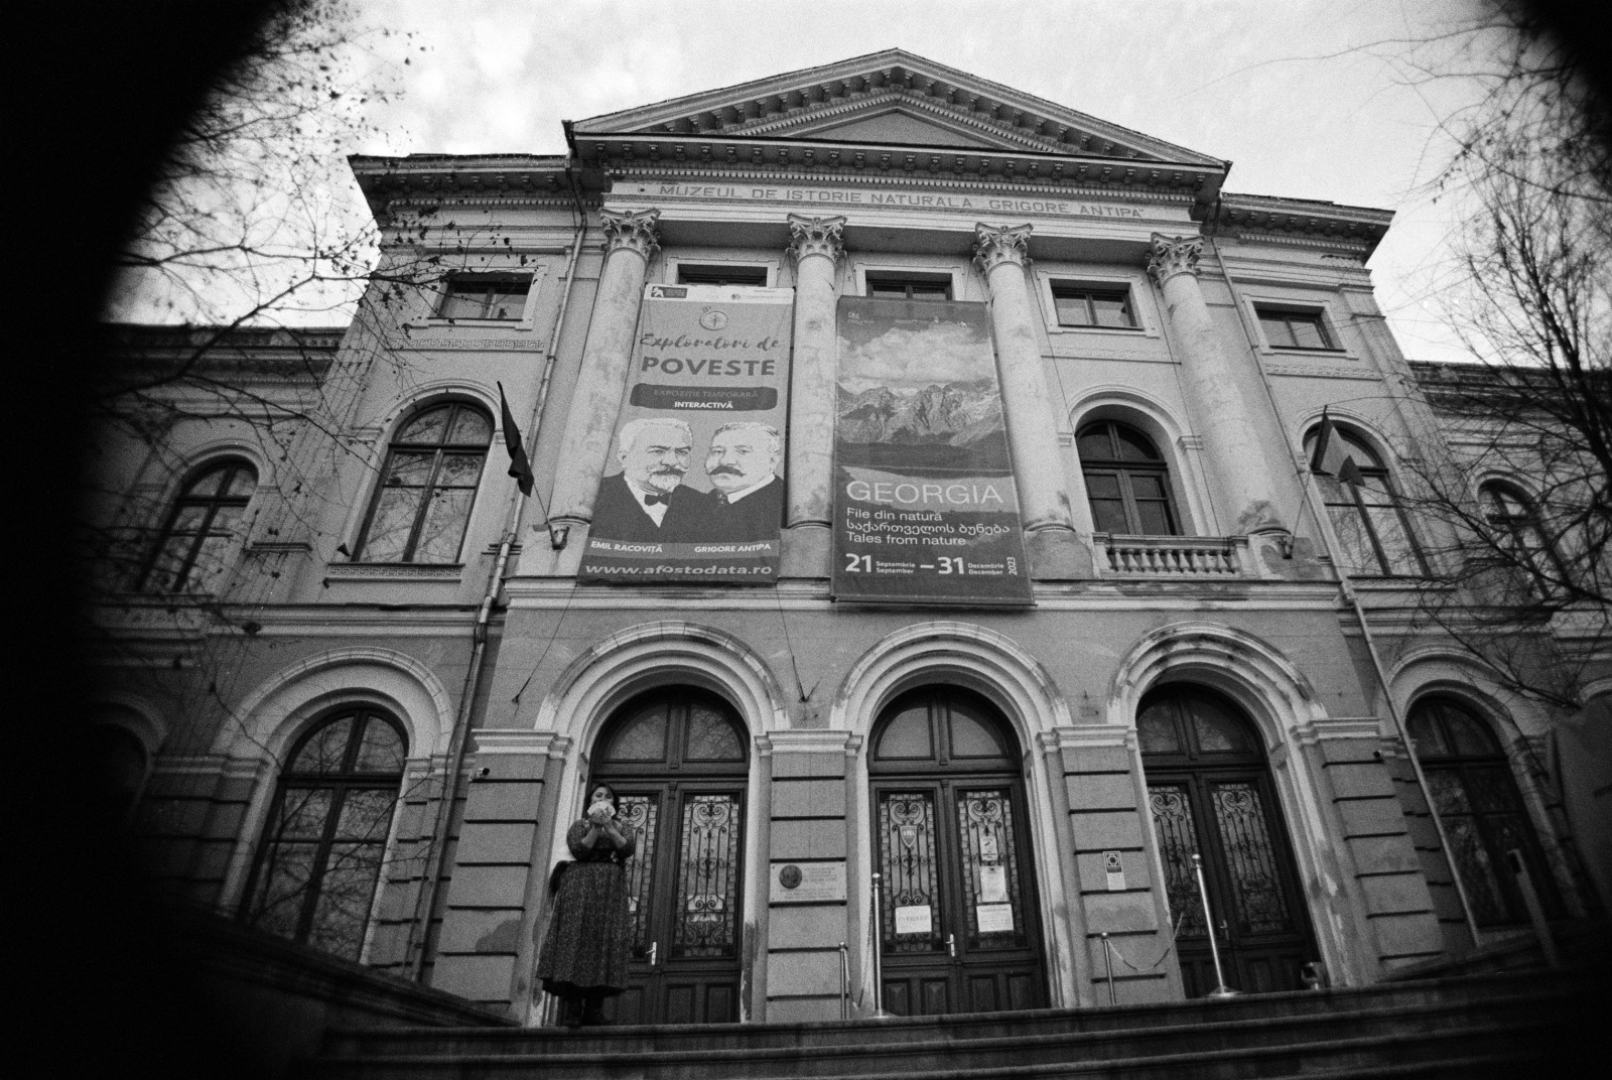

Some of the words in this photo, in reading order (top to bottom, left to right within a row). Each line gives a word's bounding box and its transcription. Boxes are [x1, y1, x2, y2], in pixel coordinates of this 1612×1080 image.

[659, 185, 742, 199] MUZEUL
[751, 188, 778, 200] DE
[786, 190, 862, 203] ISTORIE
[870, 193, 972, 208] NATURALA
[640, 333, 750, 351] Exploratori
[757, 336, 780, 351] de
[641, 356, 776, 376] POVESTE
[674, 401, 734, 409] INTERACTIVĂ
[846, 480, 1004, 504] GEORGIA
[846, 507, 870, 519] File
[874, 509, 896, 521] din
[590, 540, 612, 550] EMIL
[846, 531, 882, 544] Tales
[886, 534, 918, 545] from
[922, 536, 966, 546] nature
[694, 545, 736, 553] GRIGORE
[737, 543, 771, 552] ANTIPA
[585, 564, 773, 576] www.afostodata.ro
[845, 553, 872, 573] 21
[937, 556, 965, 575] 31
[1006, 556, 1018, 576] 2023
